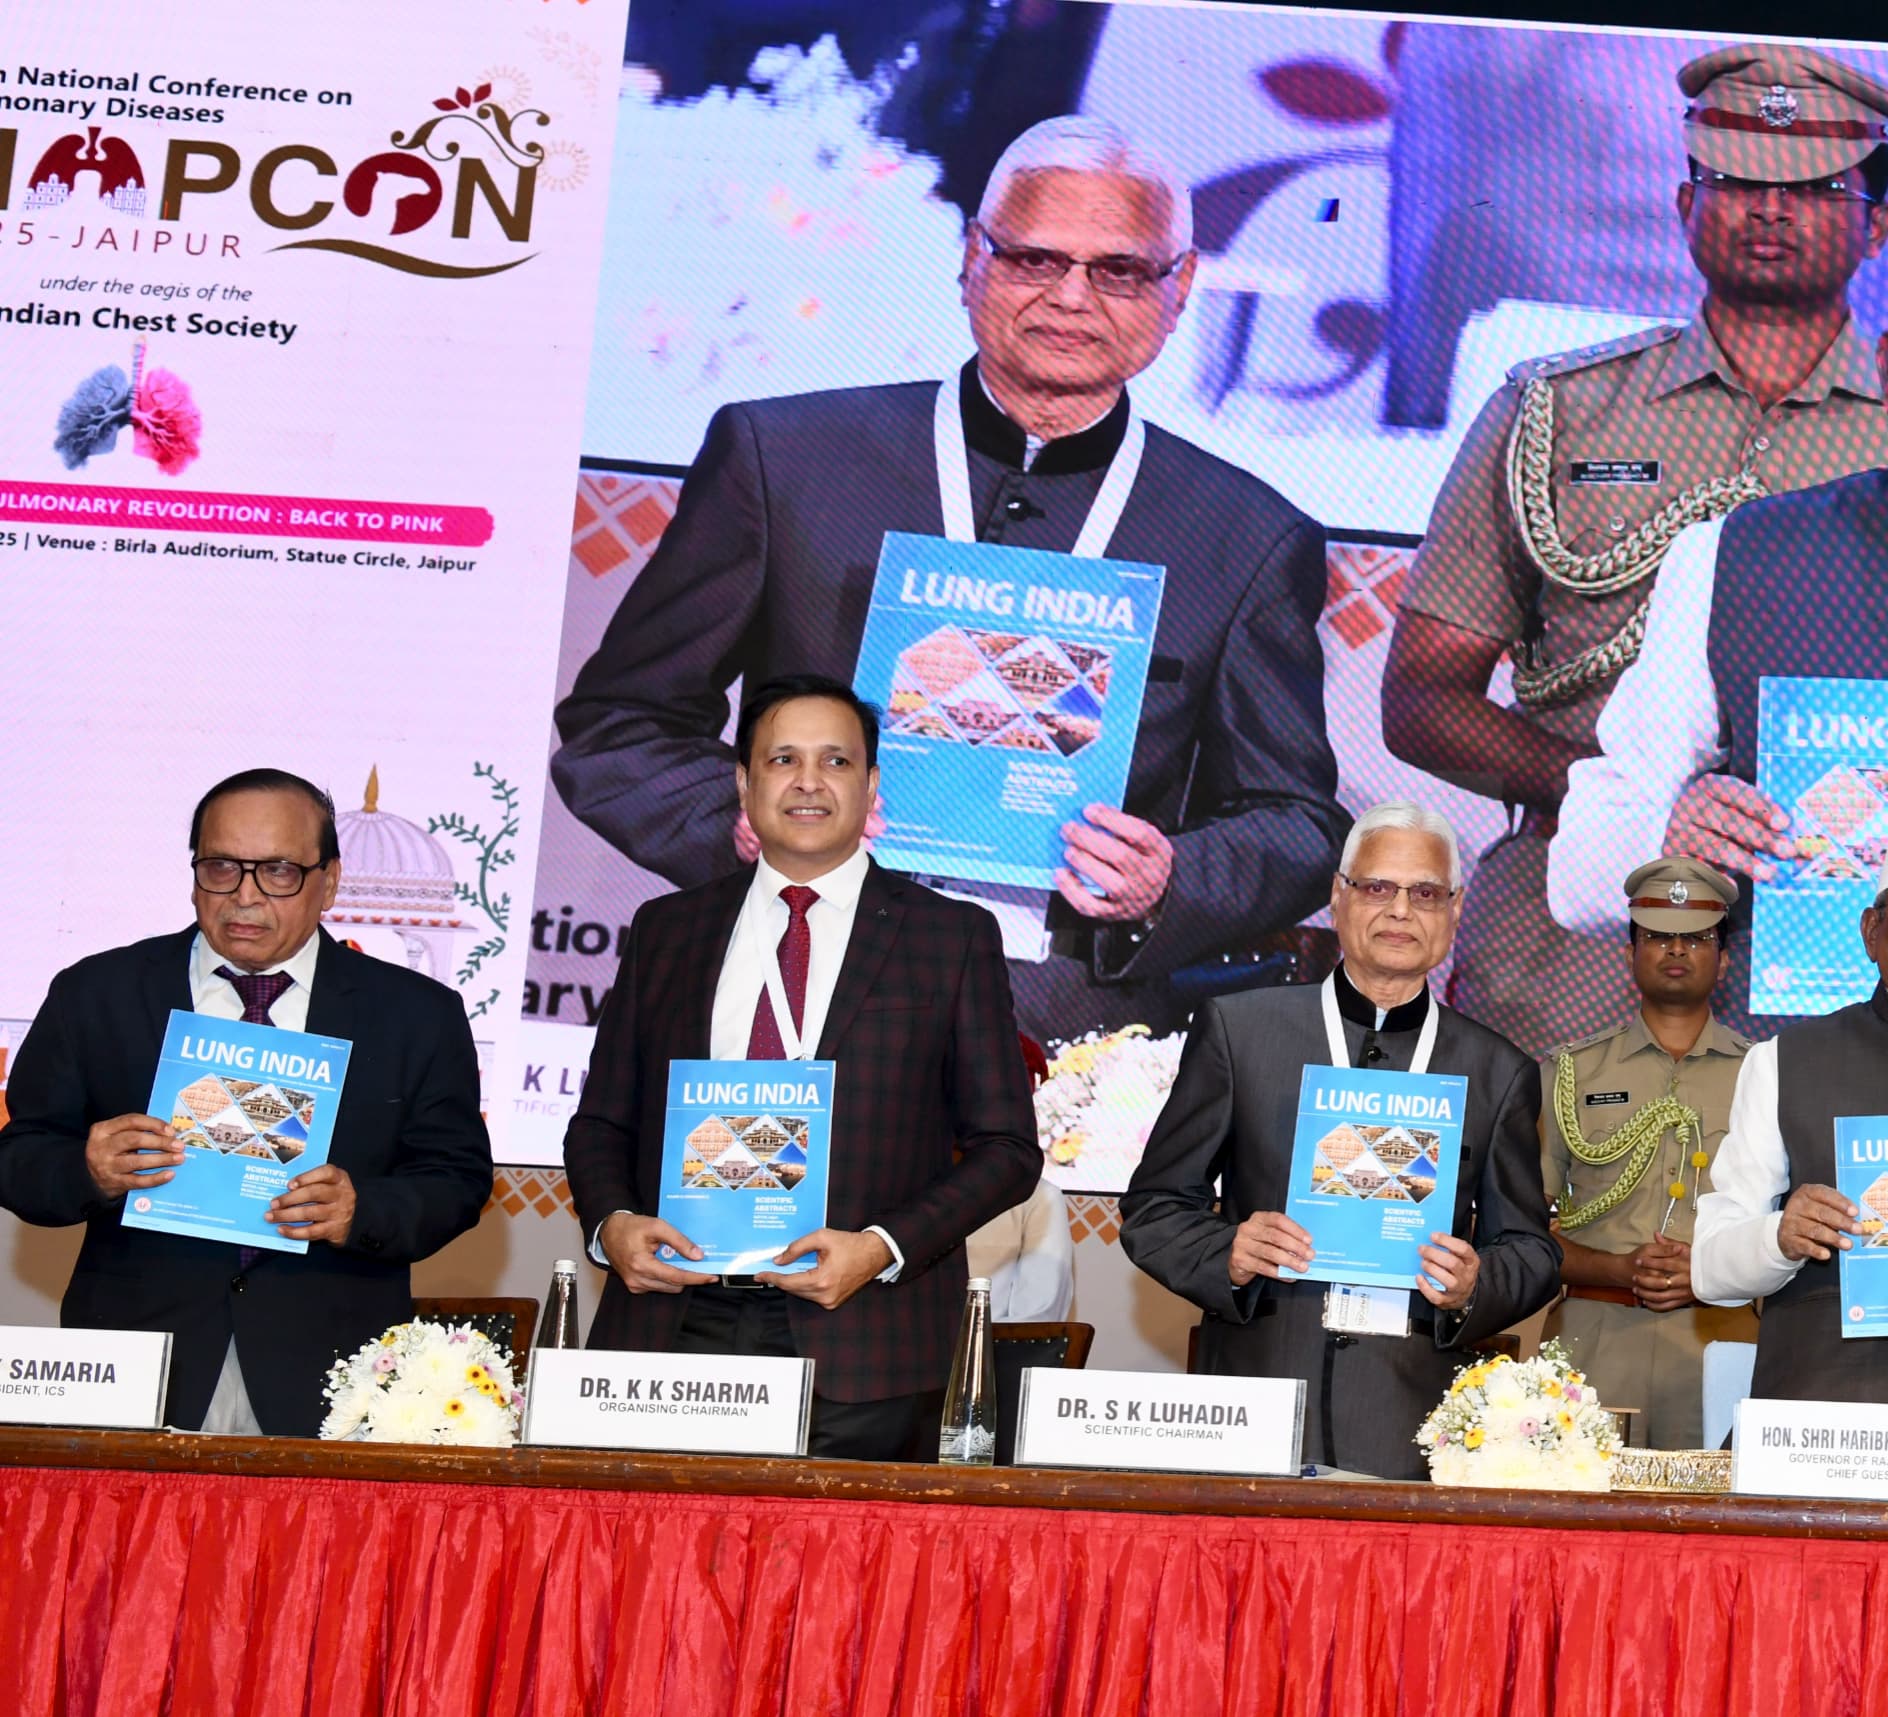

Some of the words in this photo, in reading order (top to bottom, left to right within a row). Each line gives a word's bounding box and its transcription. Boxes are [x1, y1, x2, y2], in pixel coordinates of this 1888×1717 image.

[18, 66, 138, 92] National
[149, 75, 307, 103] Conference
[318, 90, 352, 105] on
[107, 98, 224, 122] Diseases
[40, 276, 97, 292] under
[104, 279, 134, 295] the
[140, 282, 190, 300] aegis
[197, 284, 220, 302] of
[222, 286, 252, 301] the
[93, 307, 177, 333] Chest
[187, 313, 298, 345] Society
[127, 500, 270, 522] REVOLUTION
[289, 509, 348, 527] BACK
[355, 513, 384, 529] TO
[391, 515, 444, 532] PINK
[37, 534, 96, 551] Venue
[114, 539, 156, 554] Birla
[164, 542, 278, 563] Auditorium,
[286, 548, 347, 564] Statue
[353, 552, 411, 570] Circle,
[417, 555, 476, 573] Jaipur
[901, 568, 1017, 620] LUNG
[1023, 585, 1135, 632] INDIA
[181, 1035, 254, 1069] LUNG
[259, 1049, 331, 1083] INDIA
[522, 1064, 545, 1092] K
[683, 1082, 748, 1106] LUNG
[753, 1082, 820, 1105] INDIA
[1315, 1087, 1381, 1117] LUNG
[1385, 1092, 1452, 1120] INDIA
[9, 1358, 116, 1384] SAMARIA
[45, 1386, 65, 1396] ICS
[580, 1377, 617, 1399] DR.
[627, 1379, 642, 1400] K
[649, 1380, 664, 1401] K
[671, 1380, 770, 1405] SHARMA
[599, 1402, 678, 1415] ORGANISING
[682, 1405, 749, 1417] CHAIRMAN
[1057, 1397, 1096, 1420] DR.
[1104, 1400, 1118, 1421] S
[1127, 1401, 1141, 1422] K
[1149, 1401, 1249, 1428] LUHADIA
[1084, 1424, 1153, 1438] SCIENTIFIC
[1156, 1427, 1223, 1441] CHAIRMAN
[1762, 1426, 1796, 1448] HON.
[1801, 1428, 1834, 1449] SHRI
[1789, 1453, 1850, 1465] GOVERNOR
[1854, 1455, 1868, 1465] OF
[1826, 1469, 1857, 1479] CHIEF
